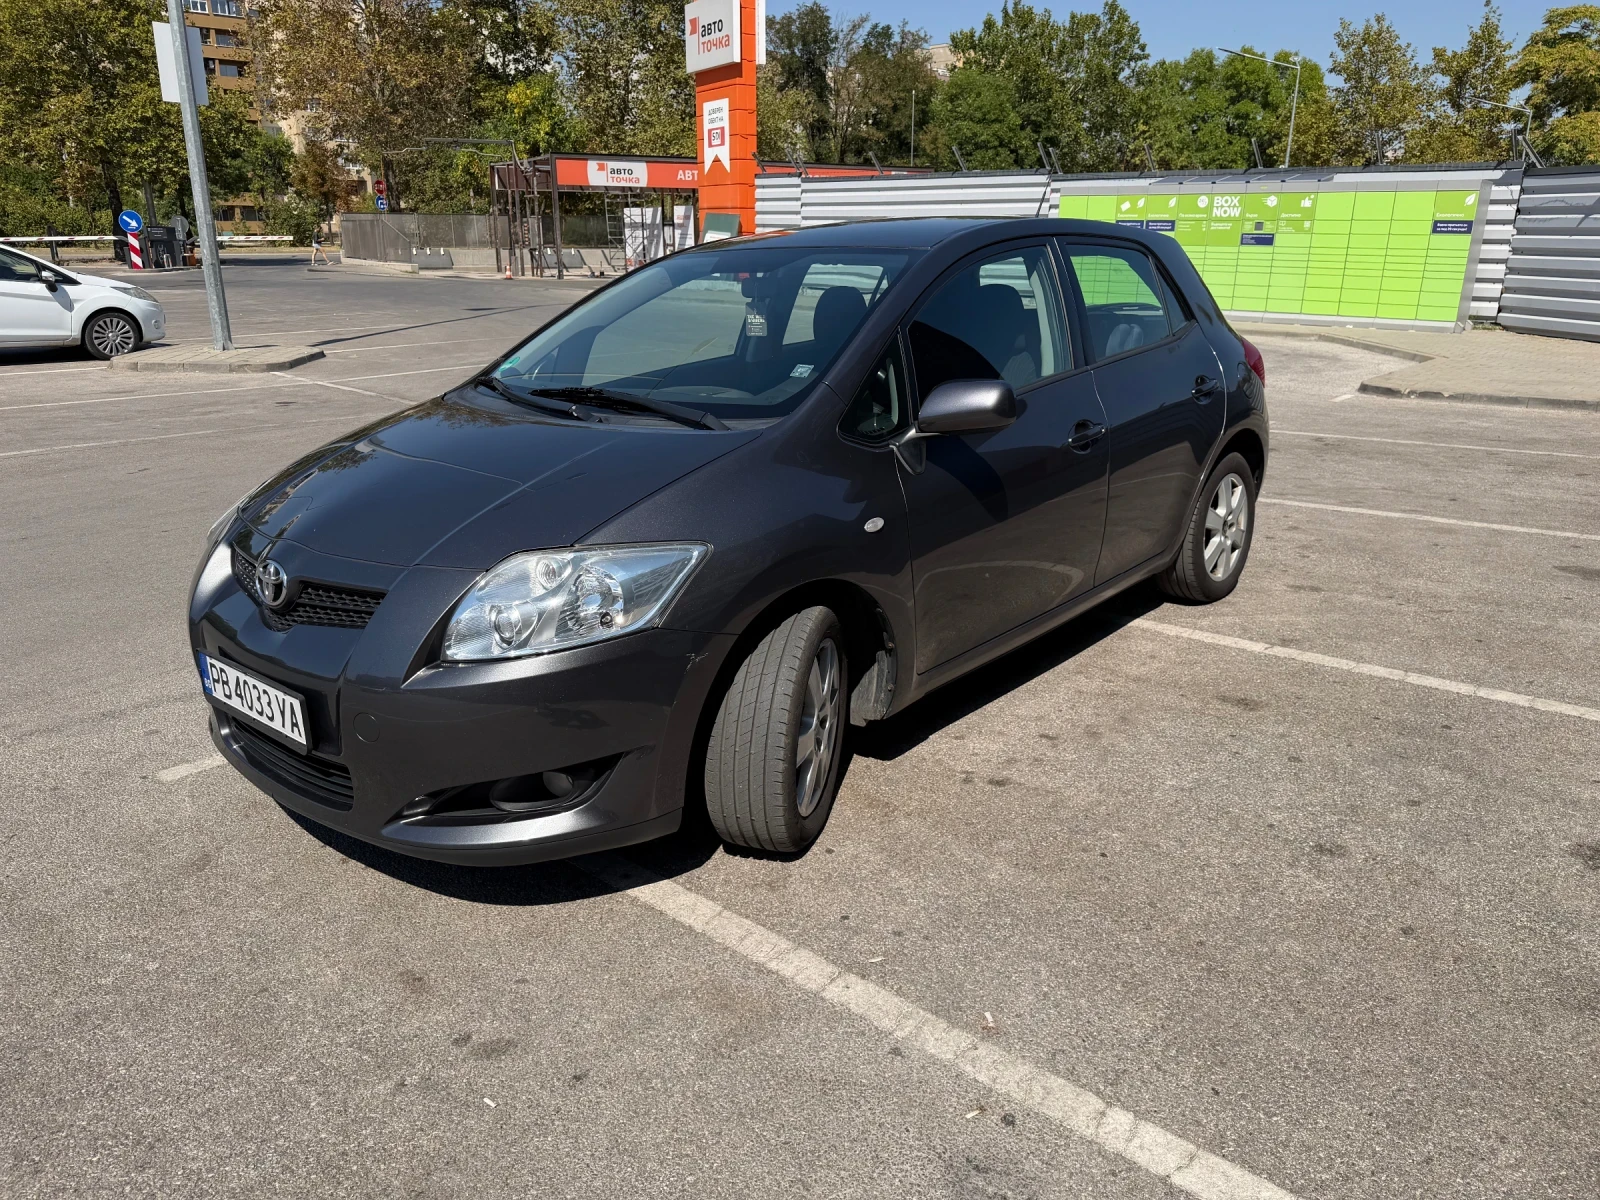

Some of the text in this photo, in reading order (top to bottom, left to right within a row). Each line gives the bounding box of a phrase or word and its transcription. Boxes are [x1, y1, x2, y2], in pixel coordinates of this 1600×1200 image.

[701, 18, 724, 38] авто
[701, 33, 730, 54] точка
[610, 166, 633, 176] авто
[610, 175, 640, 184] точка
[1213, 195, 1240, 207] BOX
[1212, 206, 1242, 218] NOW
[209, 662, 302, 738] PB 4033 YA
